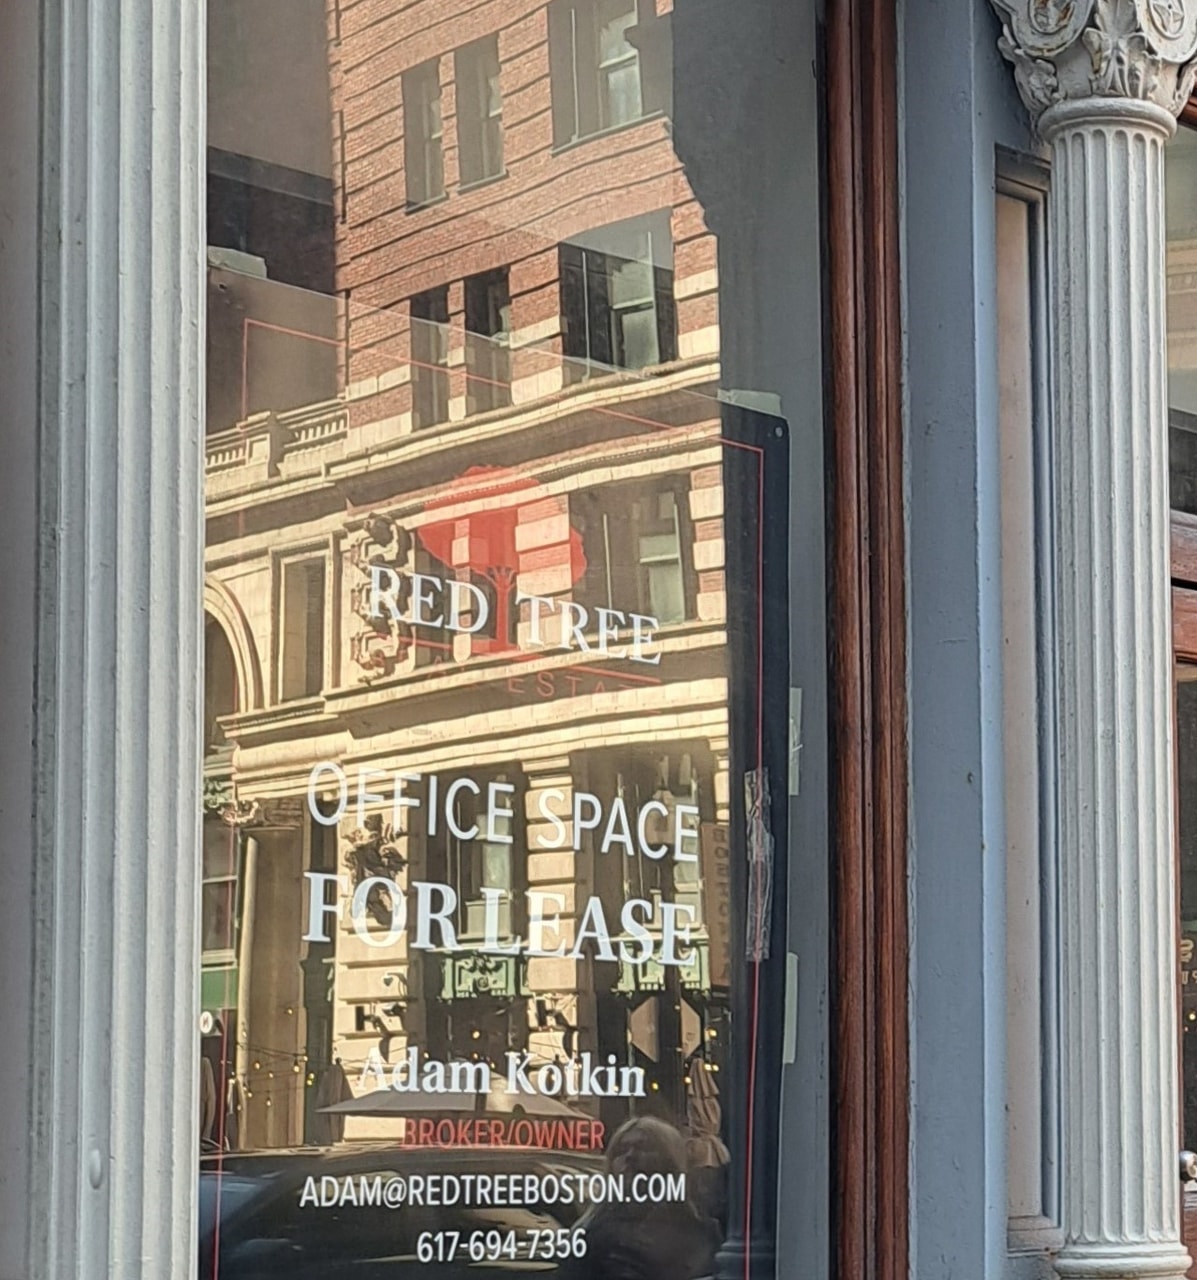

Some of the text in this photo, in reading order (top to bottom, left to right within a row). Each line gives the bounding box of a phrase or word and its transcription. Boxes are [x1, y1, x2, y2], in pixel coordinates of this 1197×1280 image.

[366, 565, 663, 665] RED TREE
[306, 760, 700, 863] OFFICE SPACE
[302, 872, 462, 952] FOR
[480, 885, 697, 967] LEASE
[353, 1046, 647, 1099] Adam Kotkin
[401, 1119, 606, 1151] BROKER/OWNER
[299, 1173, 687, 1210] ADAM@REDTREEBOSTON.COM
[416, 1228, 588, 1263] 617-694-7356
